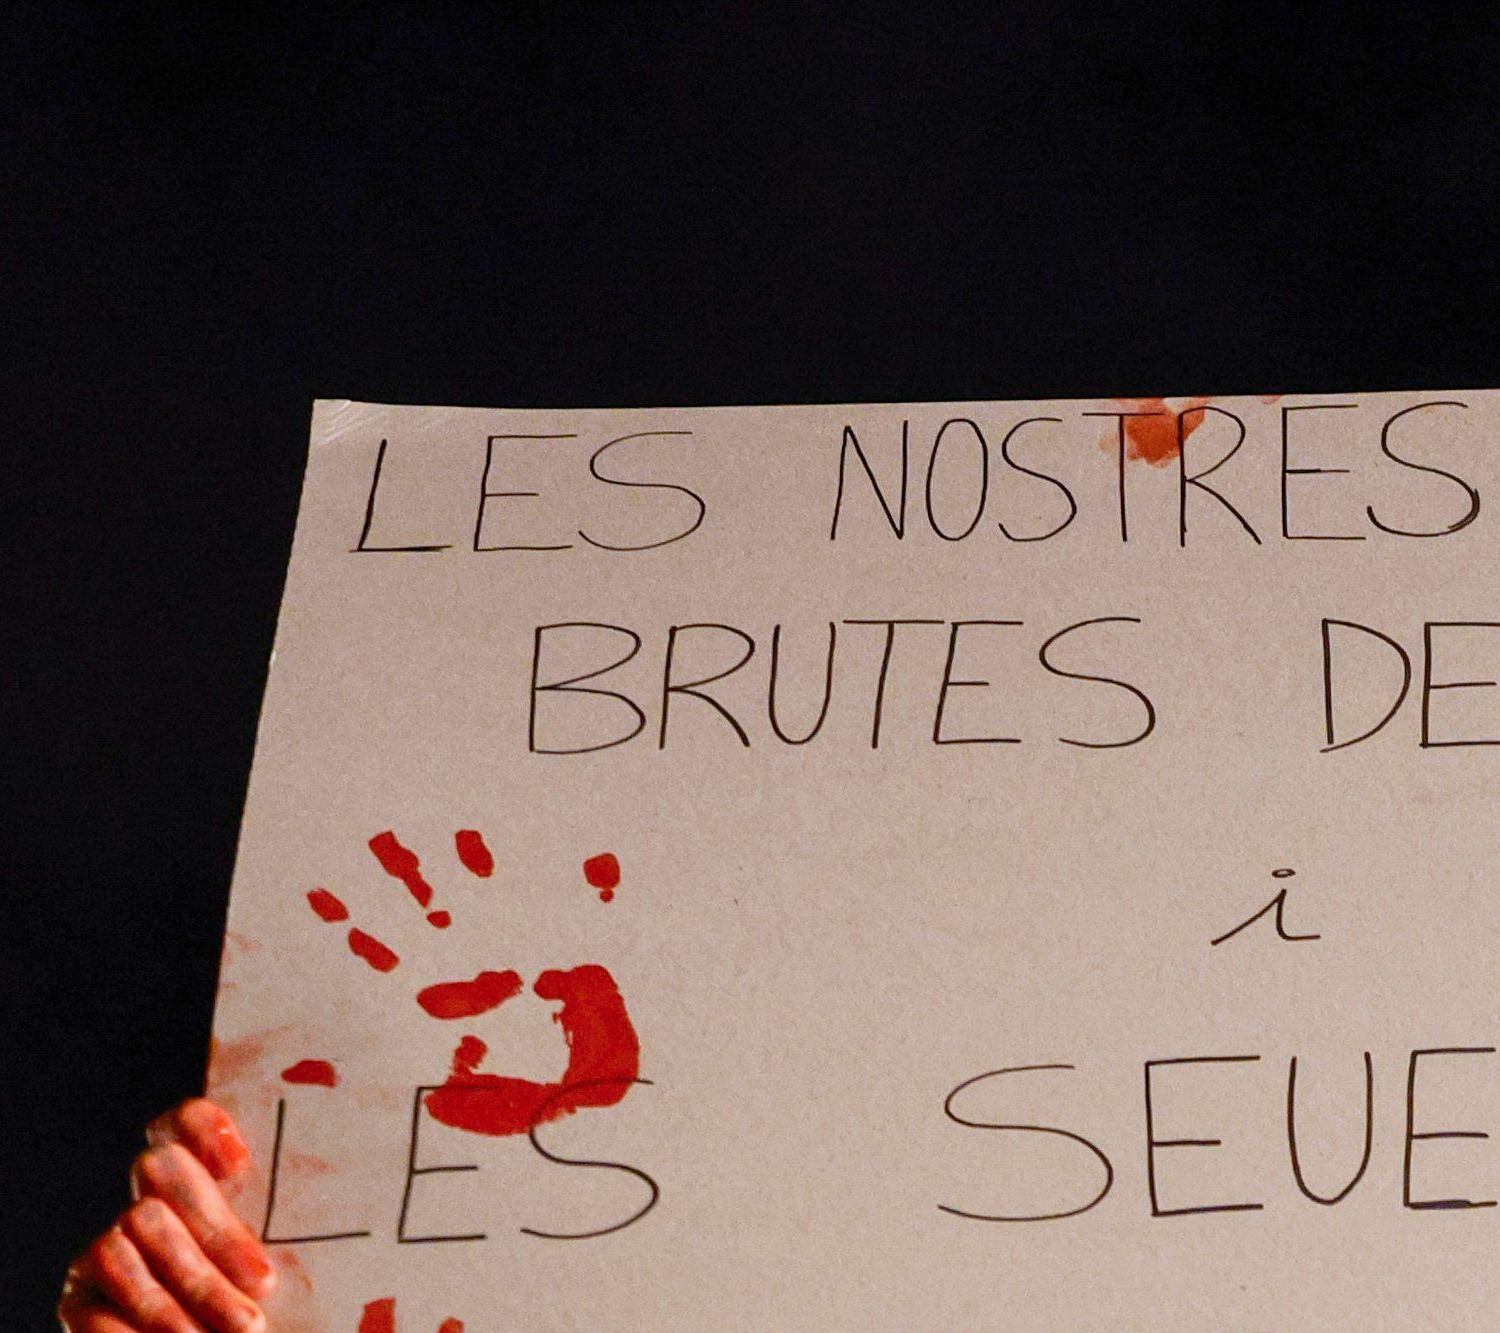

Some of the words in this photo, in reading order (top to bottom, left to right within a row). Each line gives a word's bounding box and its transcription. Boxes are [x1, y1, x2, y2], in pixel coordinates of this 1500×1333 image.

[349, 430, 705, 553] LES
[831, 401, 1481, 547] NOSTRES
[528, 616, 1156, 755] BRUTES
[261, 1077, 659, 1244] LES
